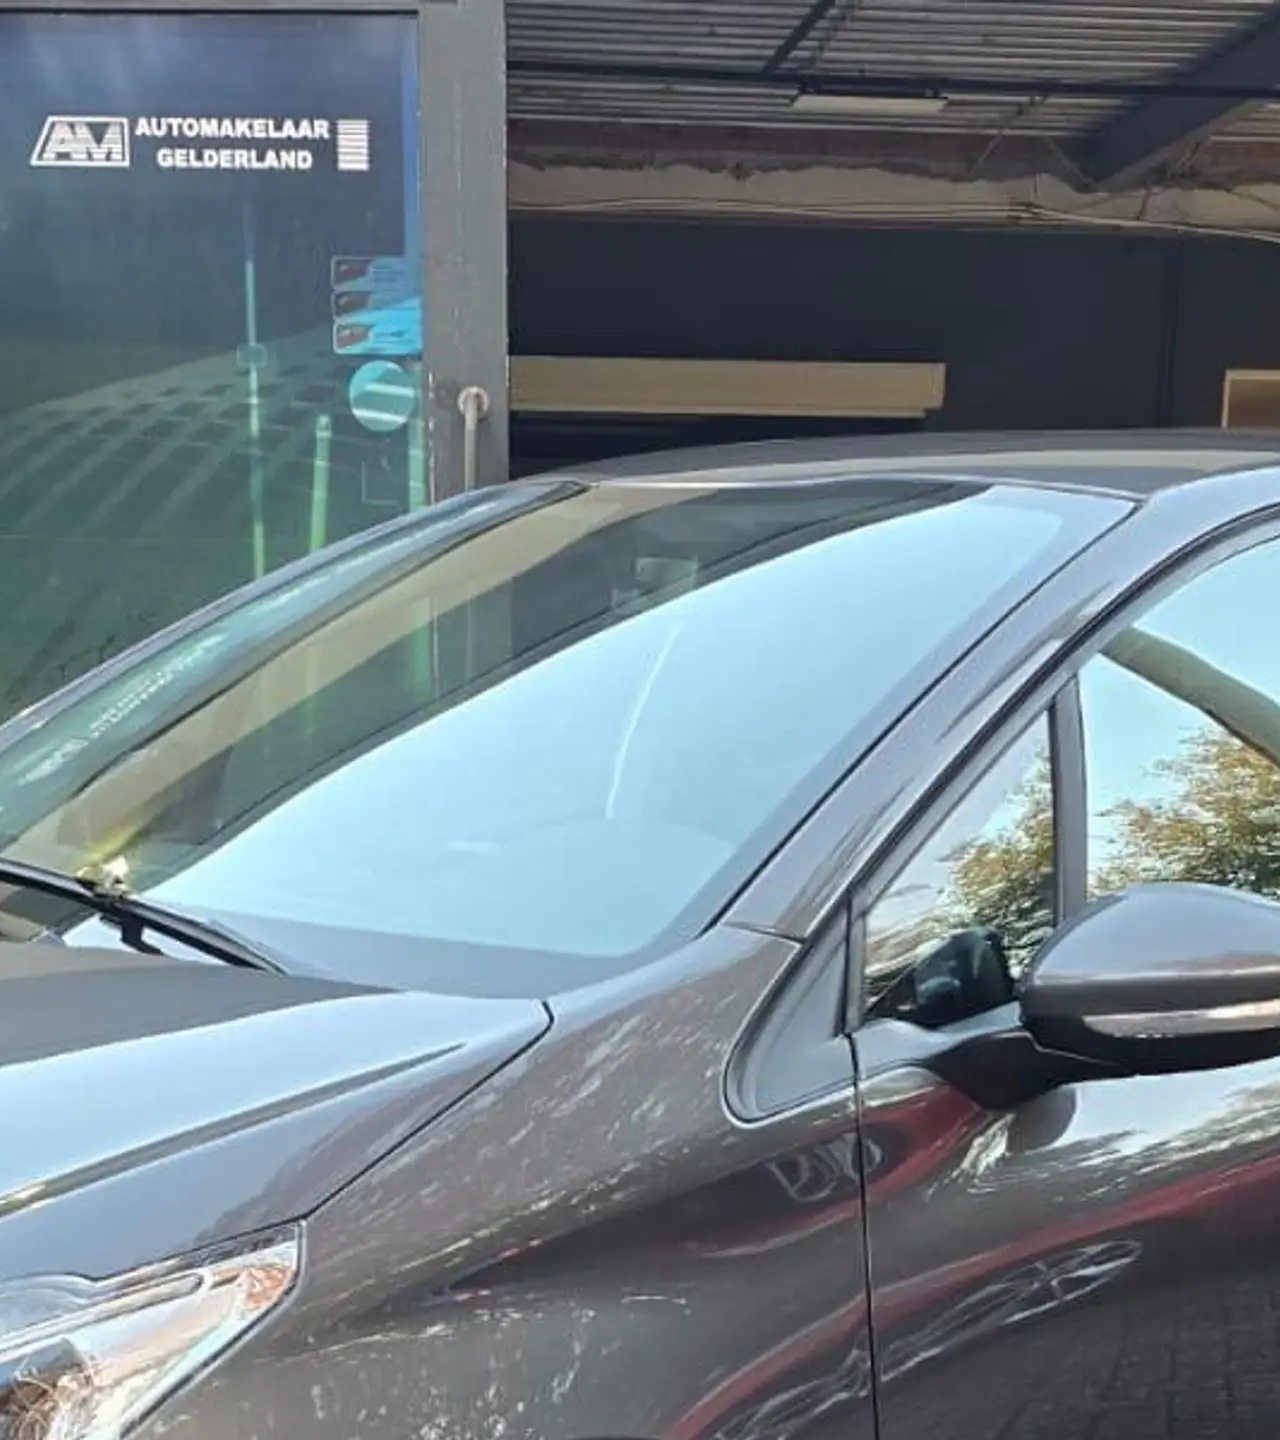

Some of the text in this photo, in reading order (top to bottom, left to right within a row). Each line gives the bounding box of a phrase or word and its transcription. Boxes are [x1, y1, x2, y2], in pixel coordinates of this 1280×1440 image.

[134, 116, 331, 139] AUTOMAKELAAR
[41, 121, 123, 161] AM
[155, 147, 314, 170] GELDERLAND
